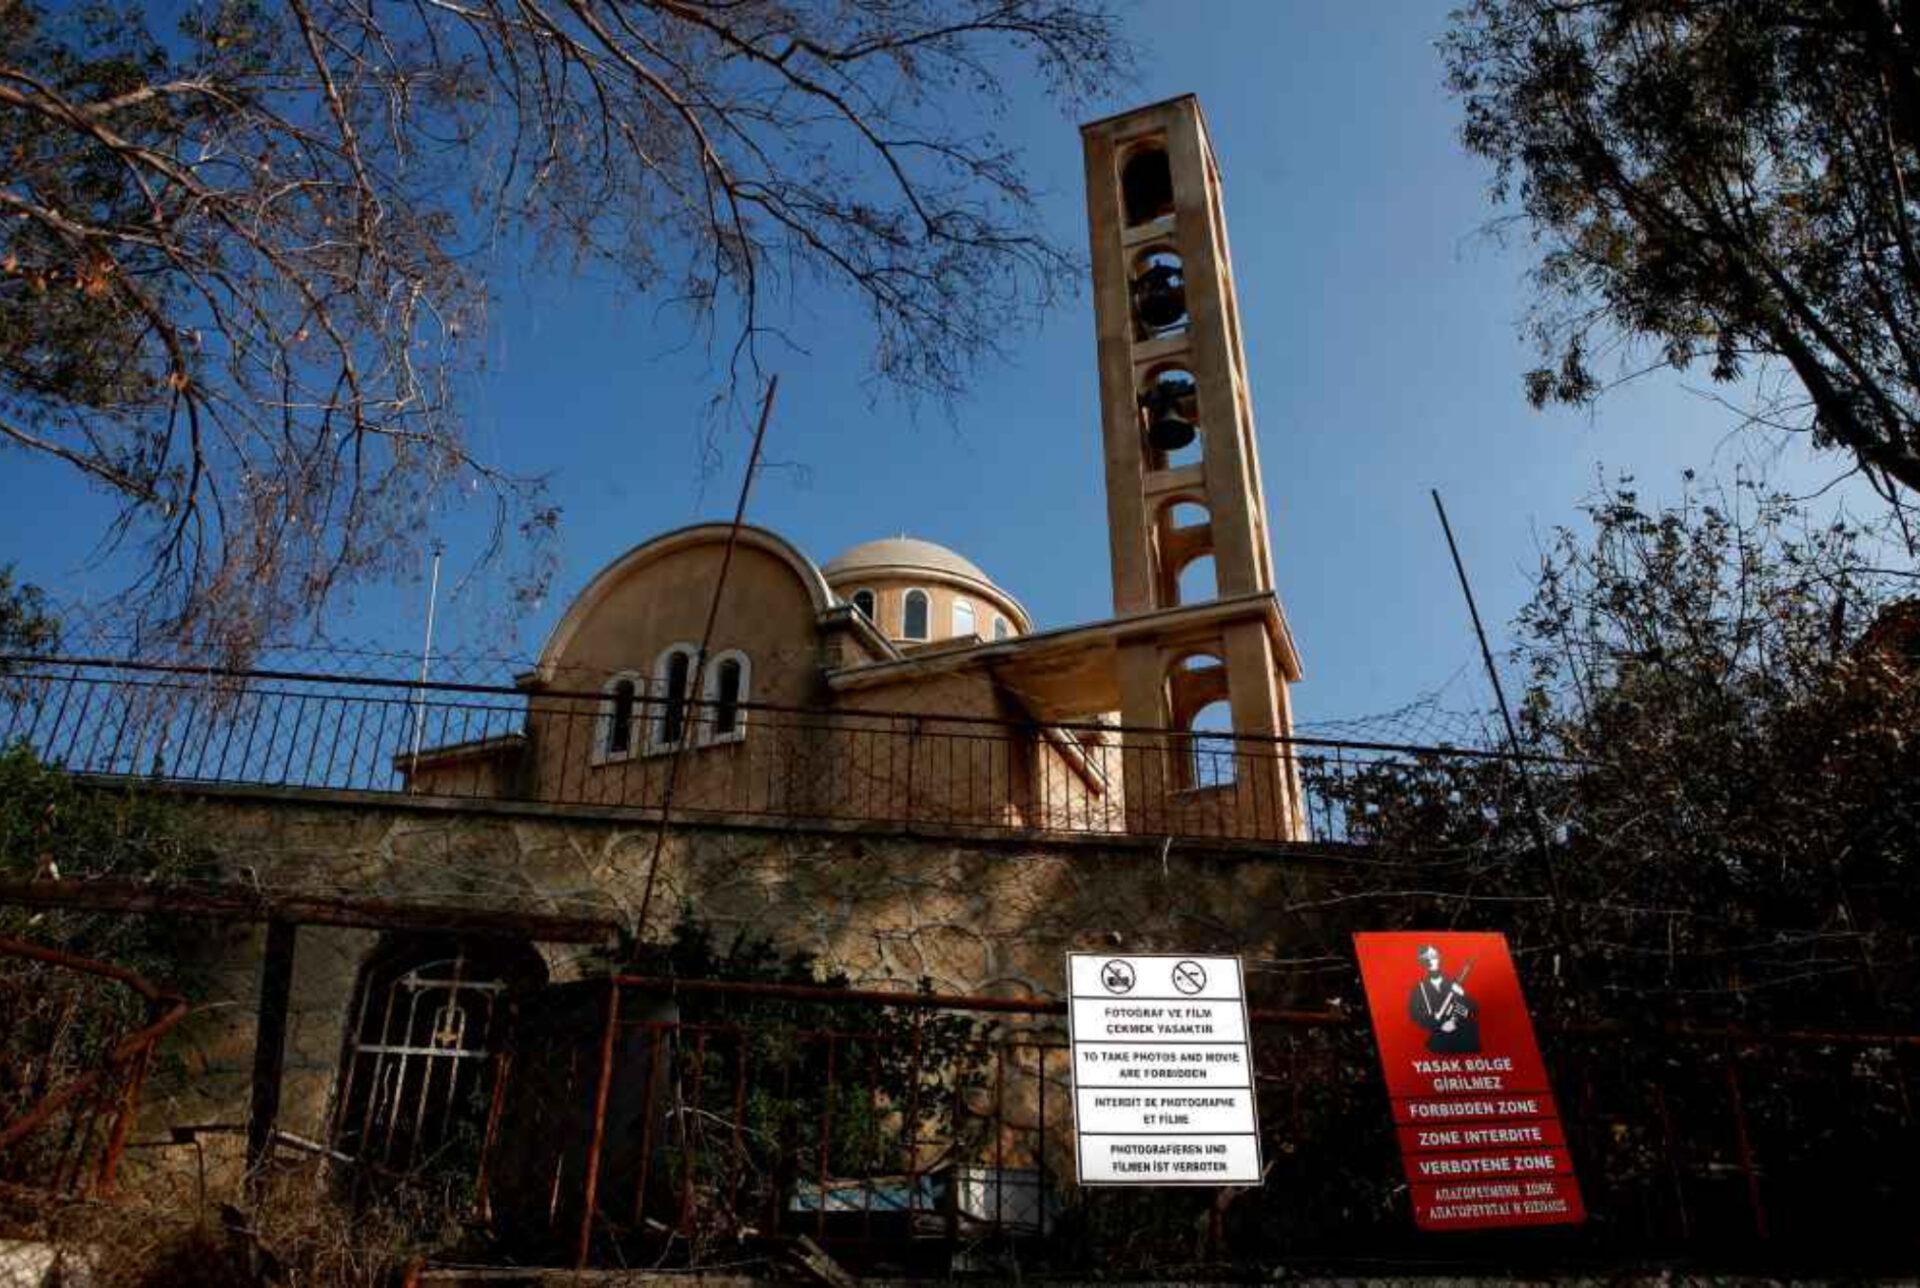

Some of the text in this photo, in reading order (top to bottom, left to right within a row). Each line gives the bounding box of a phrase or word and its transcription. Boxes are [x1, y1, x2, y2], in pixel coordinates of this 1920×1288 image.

[1168, 1008, 1182, 1018] VE
[1158, 1024, 1213, 1034] YASAKTIR
[1084, 1052, 1098, 1062] TO
[1102, 1052, 1129, 1062] TAKE
[1133, 1053, 1176, 1062] PHOTOS
[1180, 1053, 1202, 1062] AND
[1412, 1060, 1460, 1073] YASAK
[1120, 1068, 1207, 1079] ARE FORBIDDEN
[1161, 1098, 1235, 1108] PHOTOGRAPHE
[1409, 1100, 1538, 1117] FORBIDDEN ZONE
[1144, 1115, 1156, 1124] ET
[1418, 1128, 1541, 1146] ZONE INTERDITE
[1206, 1145, 1227, 1154] UND
[1173, 1162, 1227, 1172] VERBOTEN
[1420, 1156, 1556, 1175] VERBOTENE ZONE
